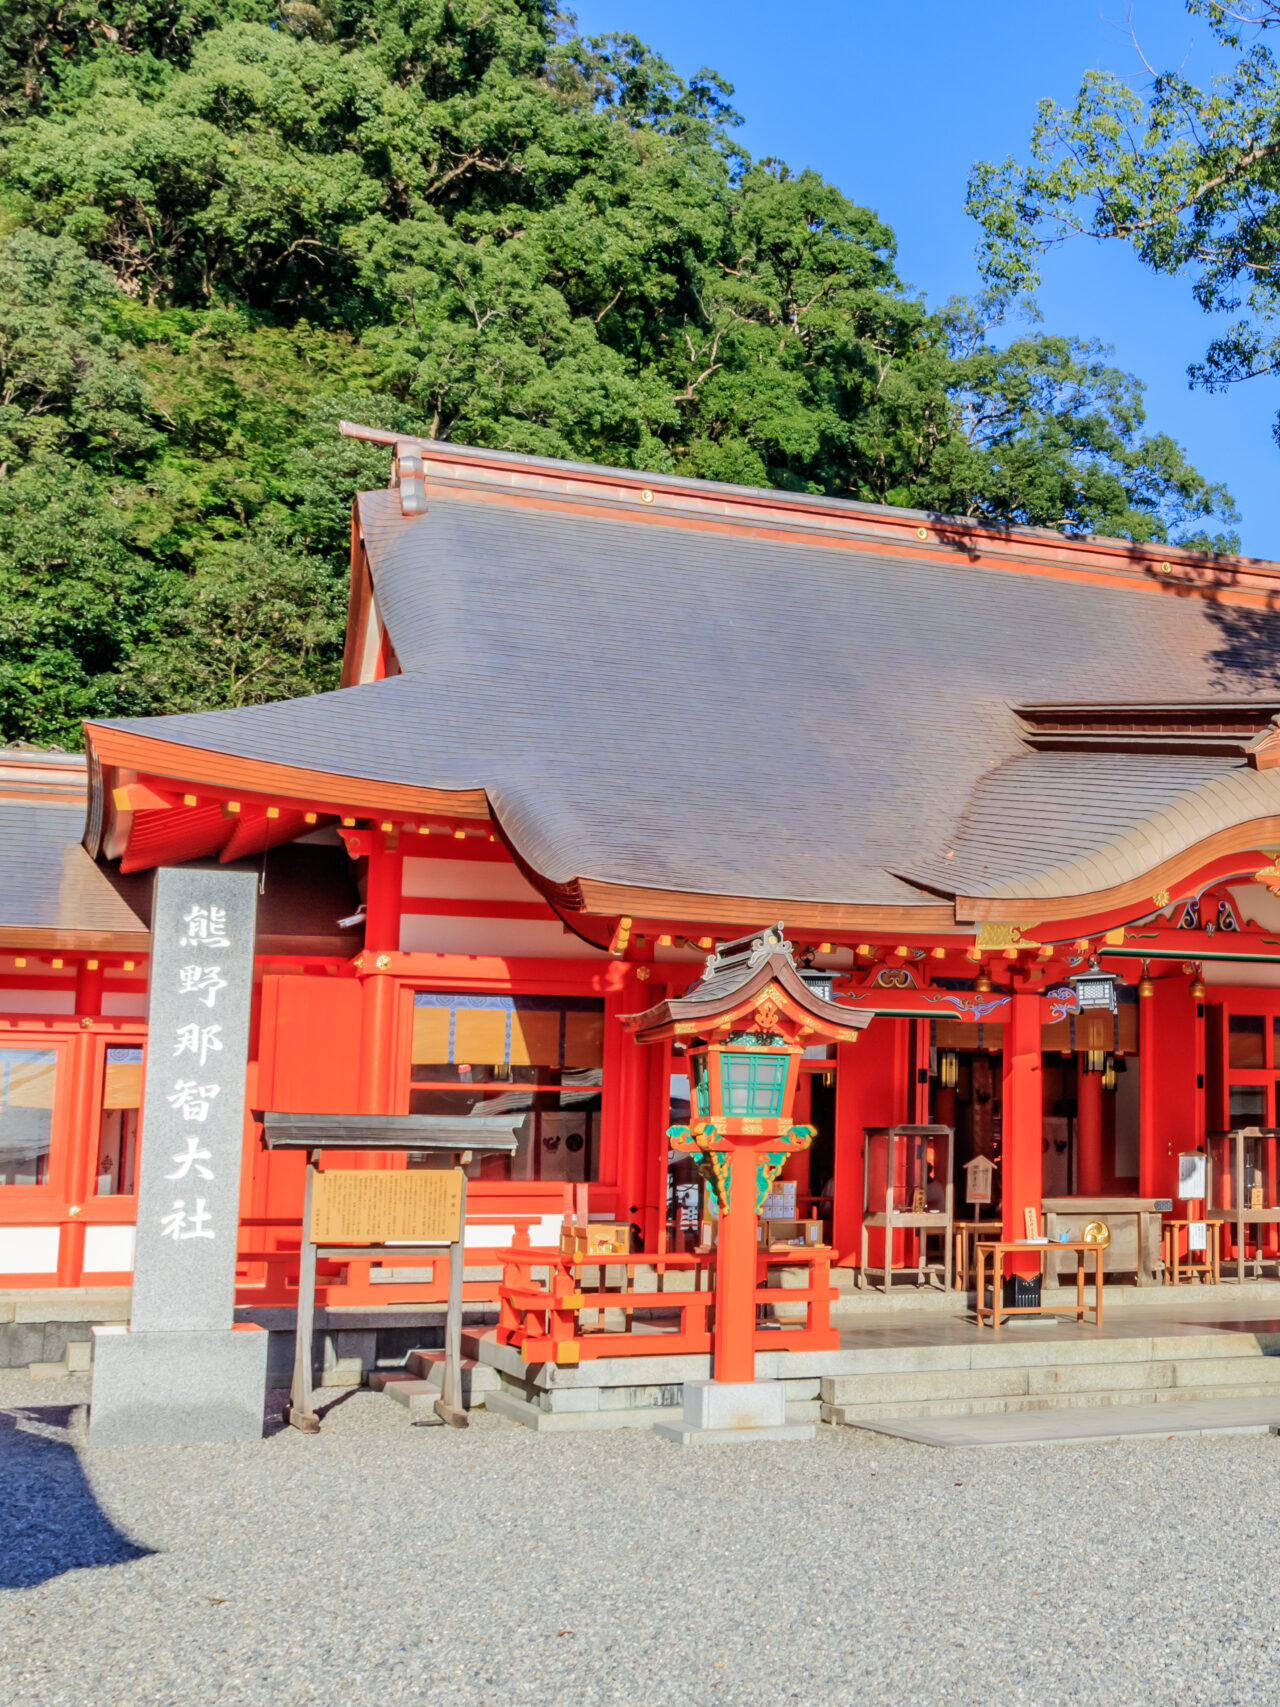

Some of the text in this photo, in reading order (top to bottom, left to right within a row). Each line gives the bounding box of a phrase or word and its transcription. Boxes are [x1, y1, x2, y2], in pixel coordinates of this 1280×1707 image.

[160, 903, 232, 1242] 熊野那智大社
